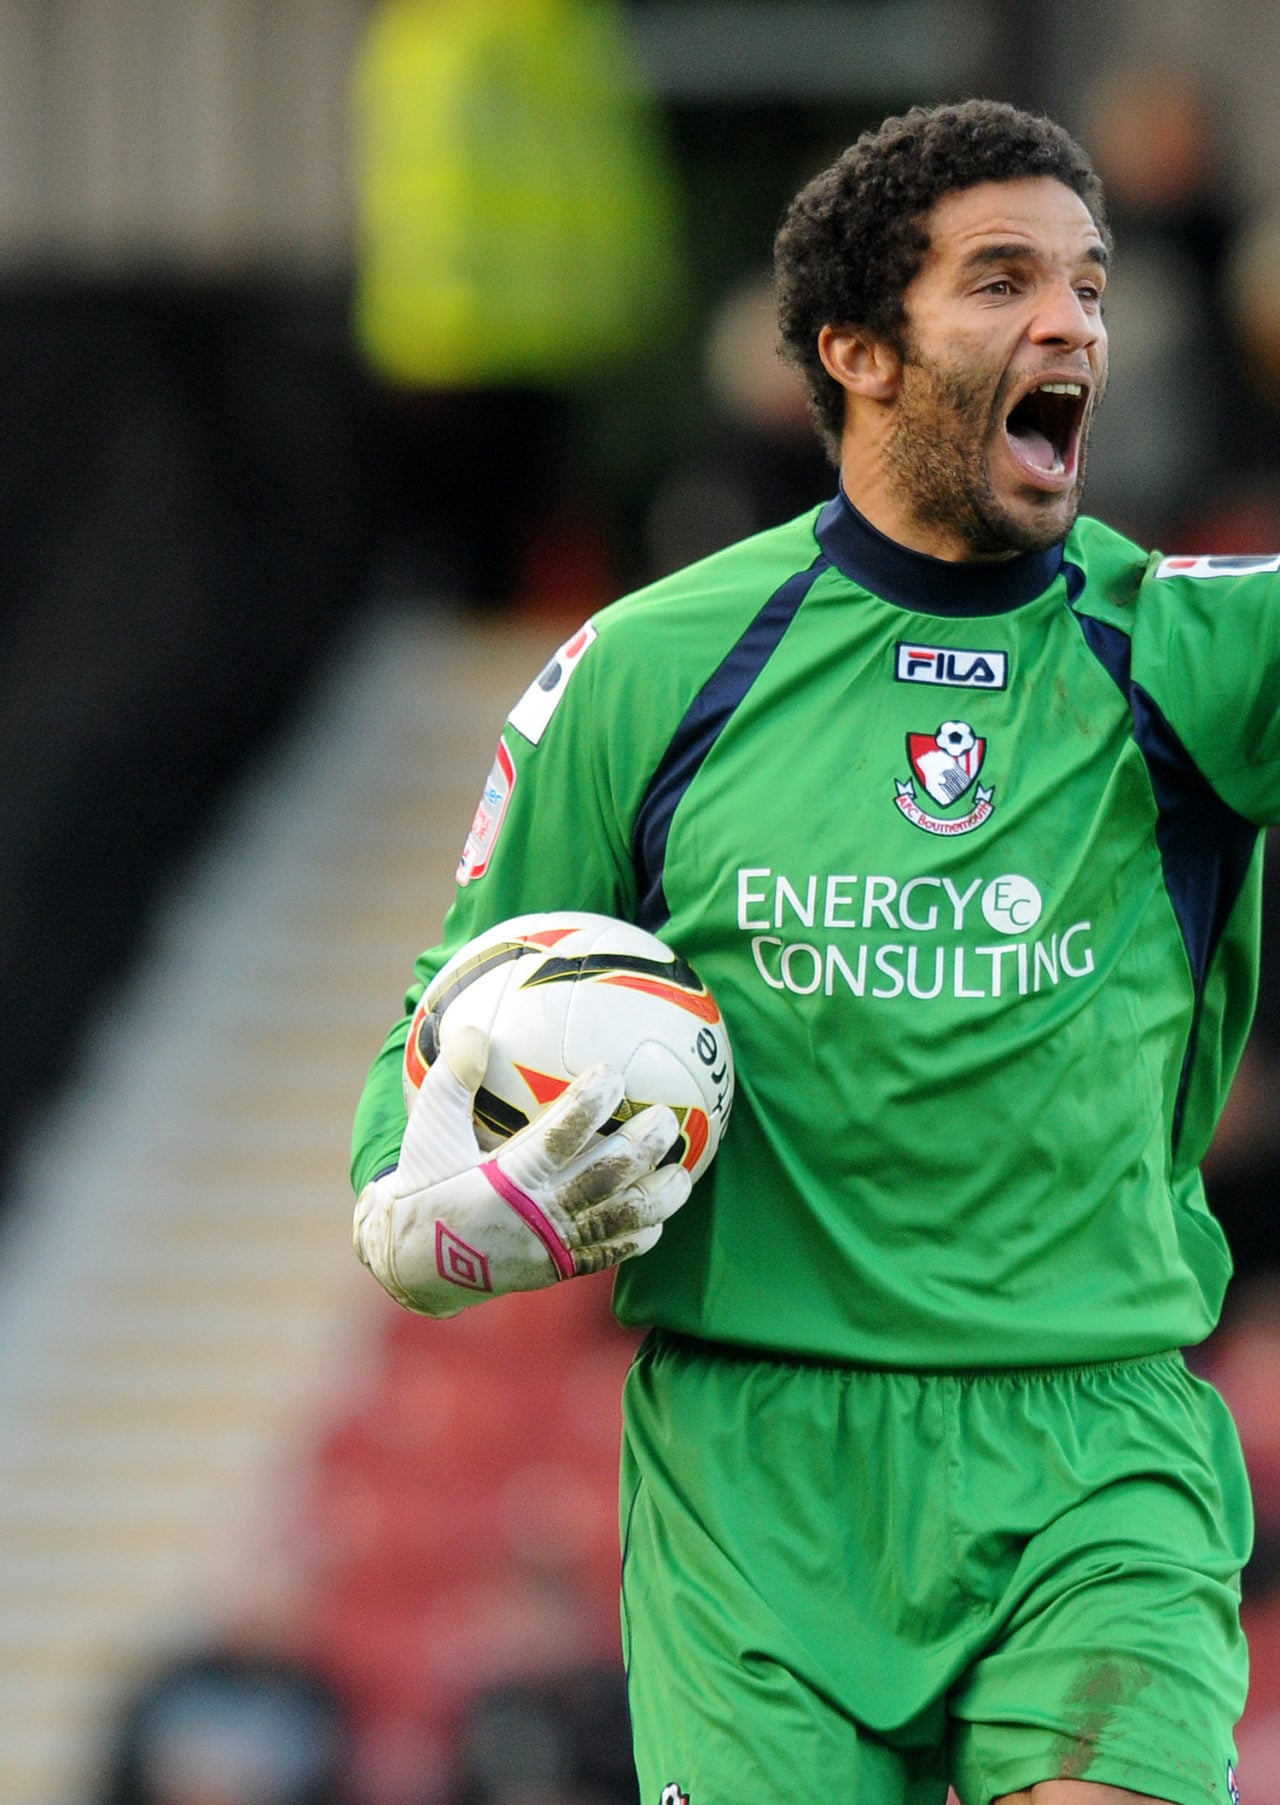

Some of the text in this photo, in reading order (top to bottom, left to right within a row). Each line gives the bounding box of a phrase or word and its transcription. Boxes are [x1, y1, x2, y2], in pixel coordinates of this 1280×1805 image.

[906, 651, 996, 683] FILA
[897, 796, 990, 833] AFC Bournemouth
[737, 868, 1034, 931] ENERGY EC
[750, 922, 1095, 1000] CONSULTING
